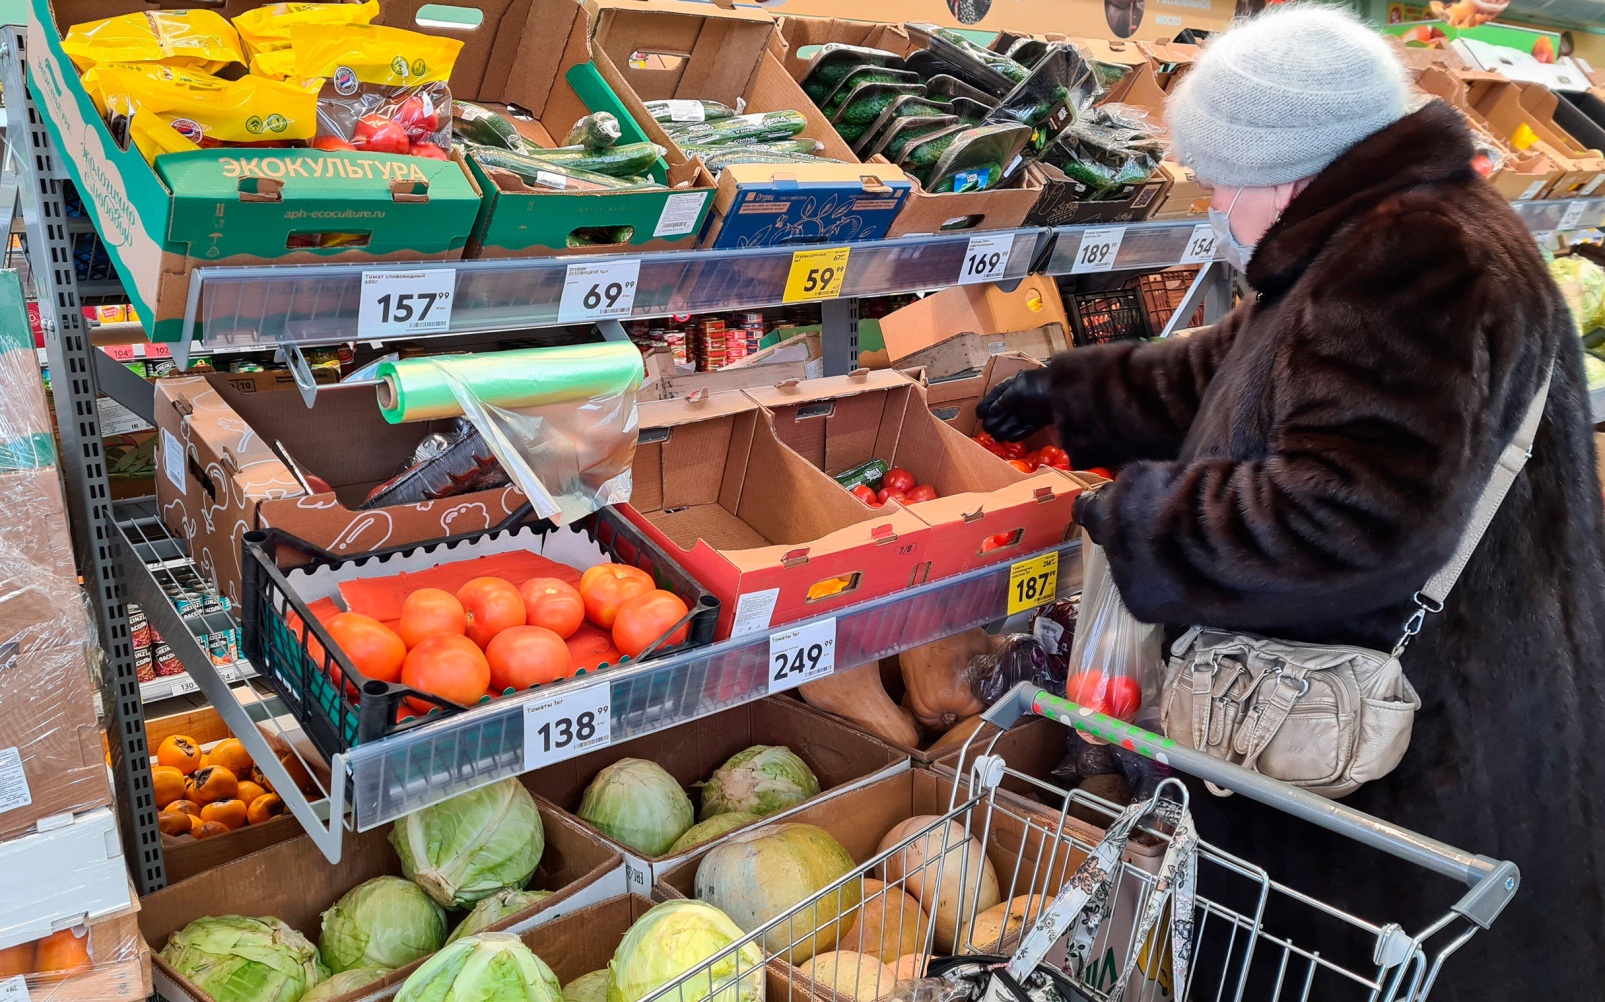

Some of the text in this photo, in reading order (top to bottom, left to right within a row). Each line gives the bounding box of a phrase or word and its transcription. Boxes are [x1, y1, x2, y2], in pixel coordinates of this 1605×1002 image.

[218, 157, 429, 181] ЭКОКУЛЬТУРА
[284, 209, 386, 220] aph-ecoculture.ru
[1190, 237, 1215, 257] 154
[1081, 243, 1111, 264] 189
[968, 252, 1001, 275] 169
[803, 267, 835, 292] 59
[583, 282, 623, 310] 69
[377, 292, 450, 323] 157 99
[156, 346, 169, 354] 102
[157, 361, 174, 371] HEINZ
[240, 382, 251, 390] 10
[899, 544, 913, 555] 7/8
[1016, 572, 1050, 603] 187
[129, 615, 144, 625] EINZ
[131, 621, 147, 632] АСОЛЬ
[772, 634, 792, 643] Томаты
[135, 650, 147, 659] INZ
[773, 643, 823, 681] 249
[824, 639, 833, 647] 99
[136, 657, 151, 666] СОЛЬ
[181, 682, 194, 690] 130
[527, 702, 553, 714] Томаты
[537, 705, 609, 753] 138 99
